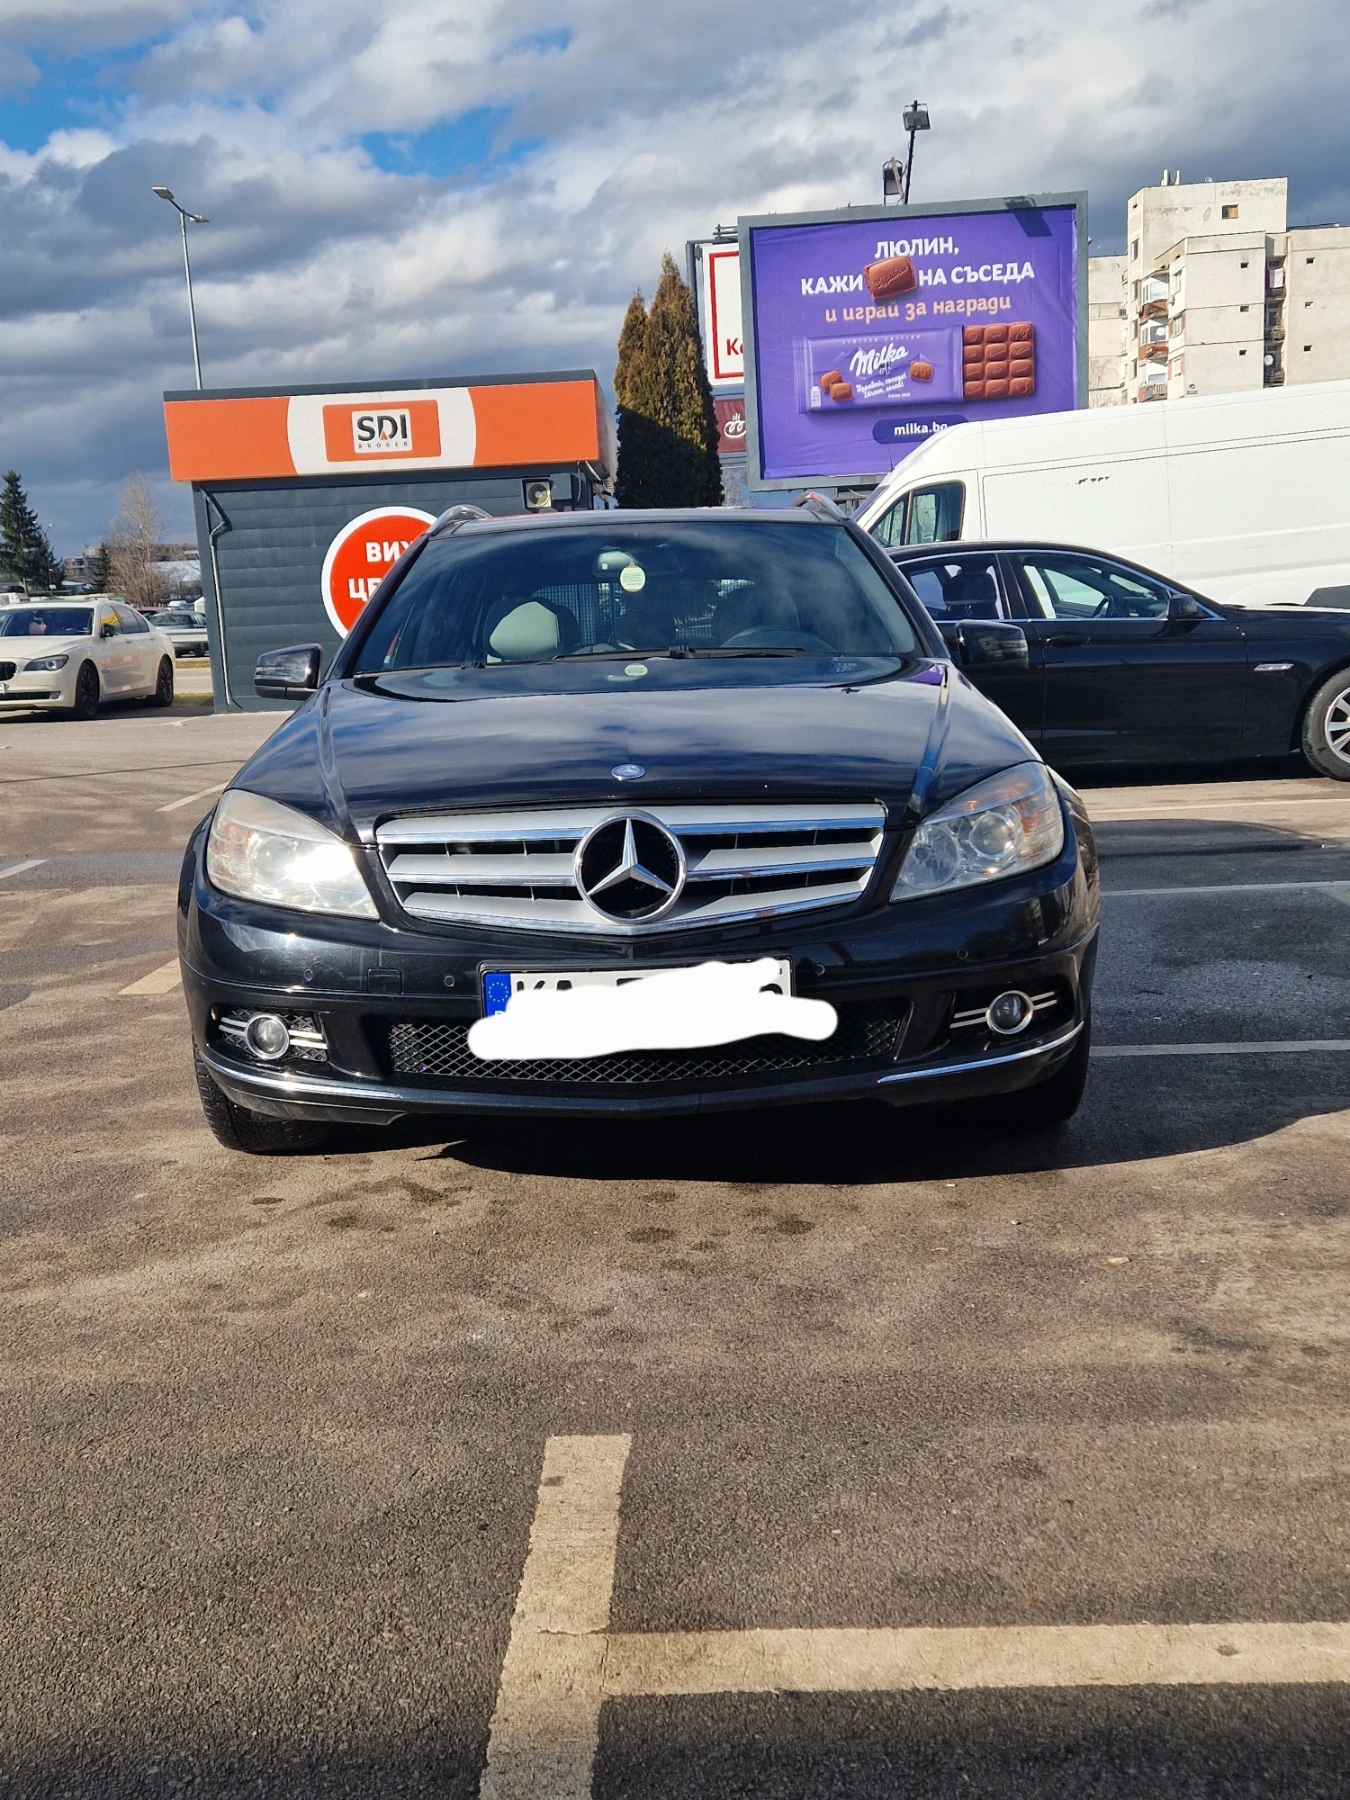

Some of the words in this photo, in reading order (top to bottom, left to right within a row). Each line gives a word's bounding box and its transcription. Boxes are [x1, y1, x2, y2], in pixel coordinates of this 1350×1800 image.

[875, 236, 960, 259] ЛЮЛИН,
[801, 274, 864, 295] КАЖИ
[918, 268, 947, 286] НА
[951, 262, 1035, 284] СЪСЕДА
[825, 309, 837, 322] и
[843, 300, 900, 325] играй
[905, 301, 927, 321] за
[933, 296, 1011, 317] награди
[726, 337, 744, 356] K
[849, 343, 909, 377] Milka
[356, 414, 408, 441] SDI
[358, 441, 408, 449] BROKER
